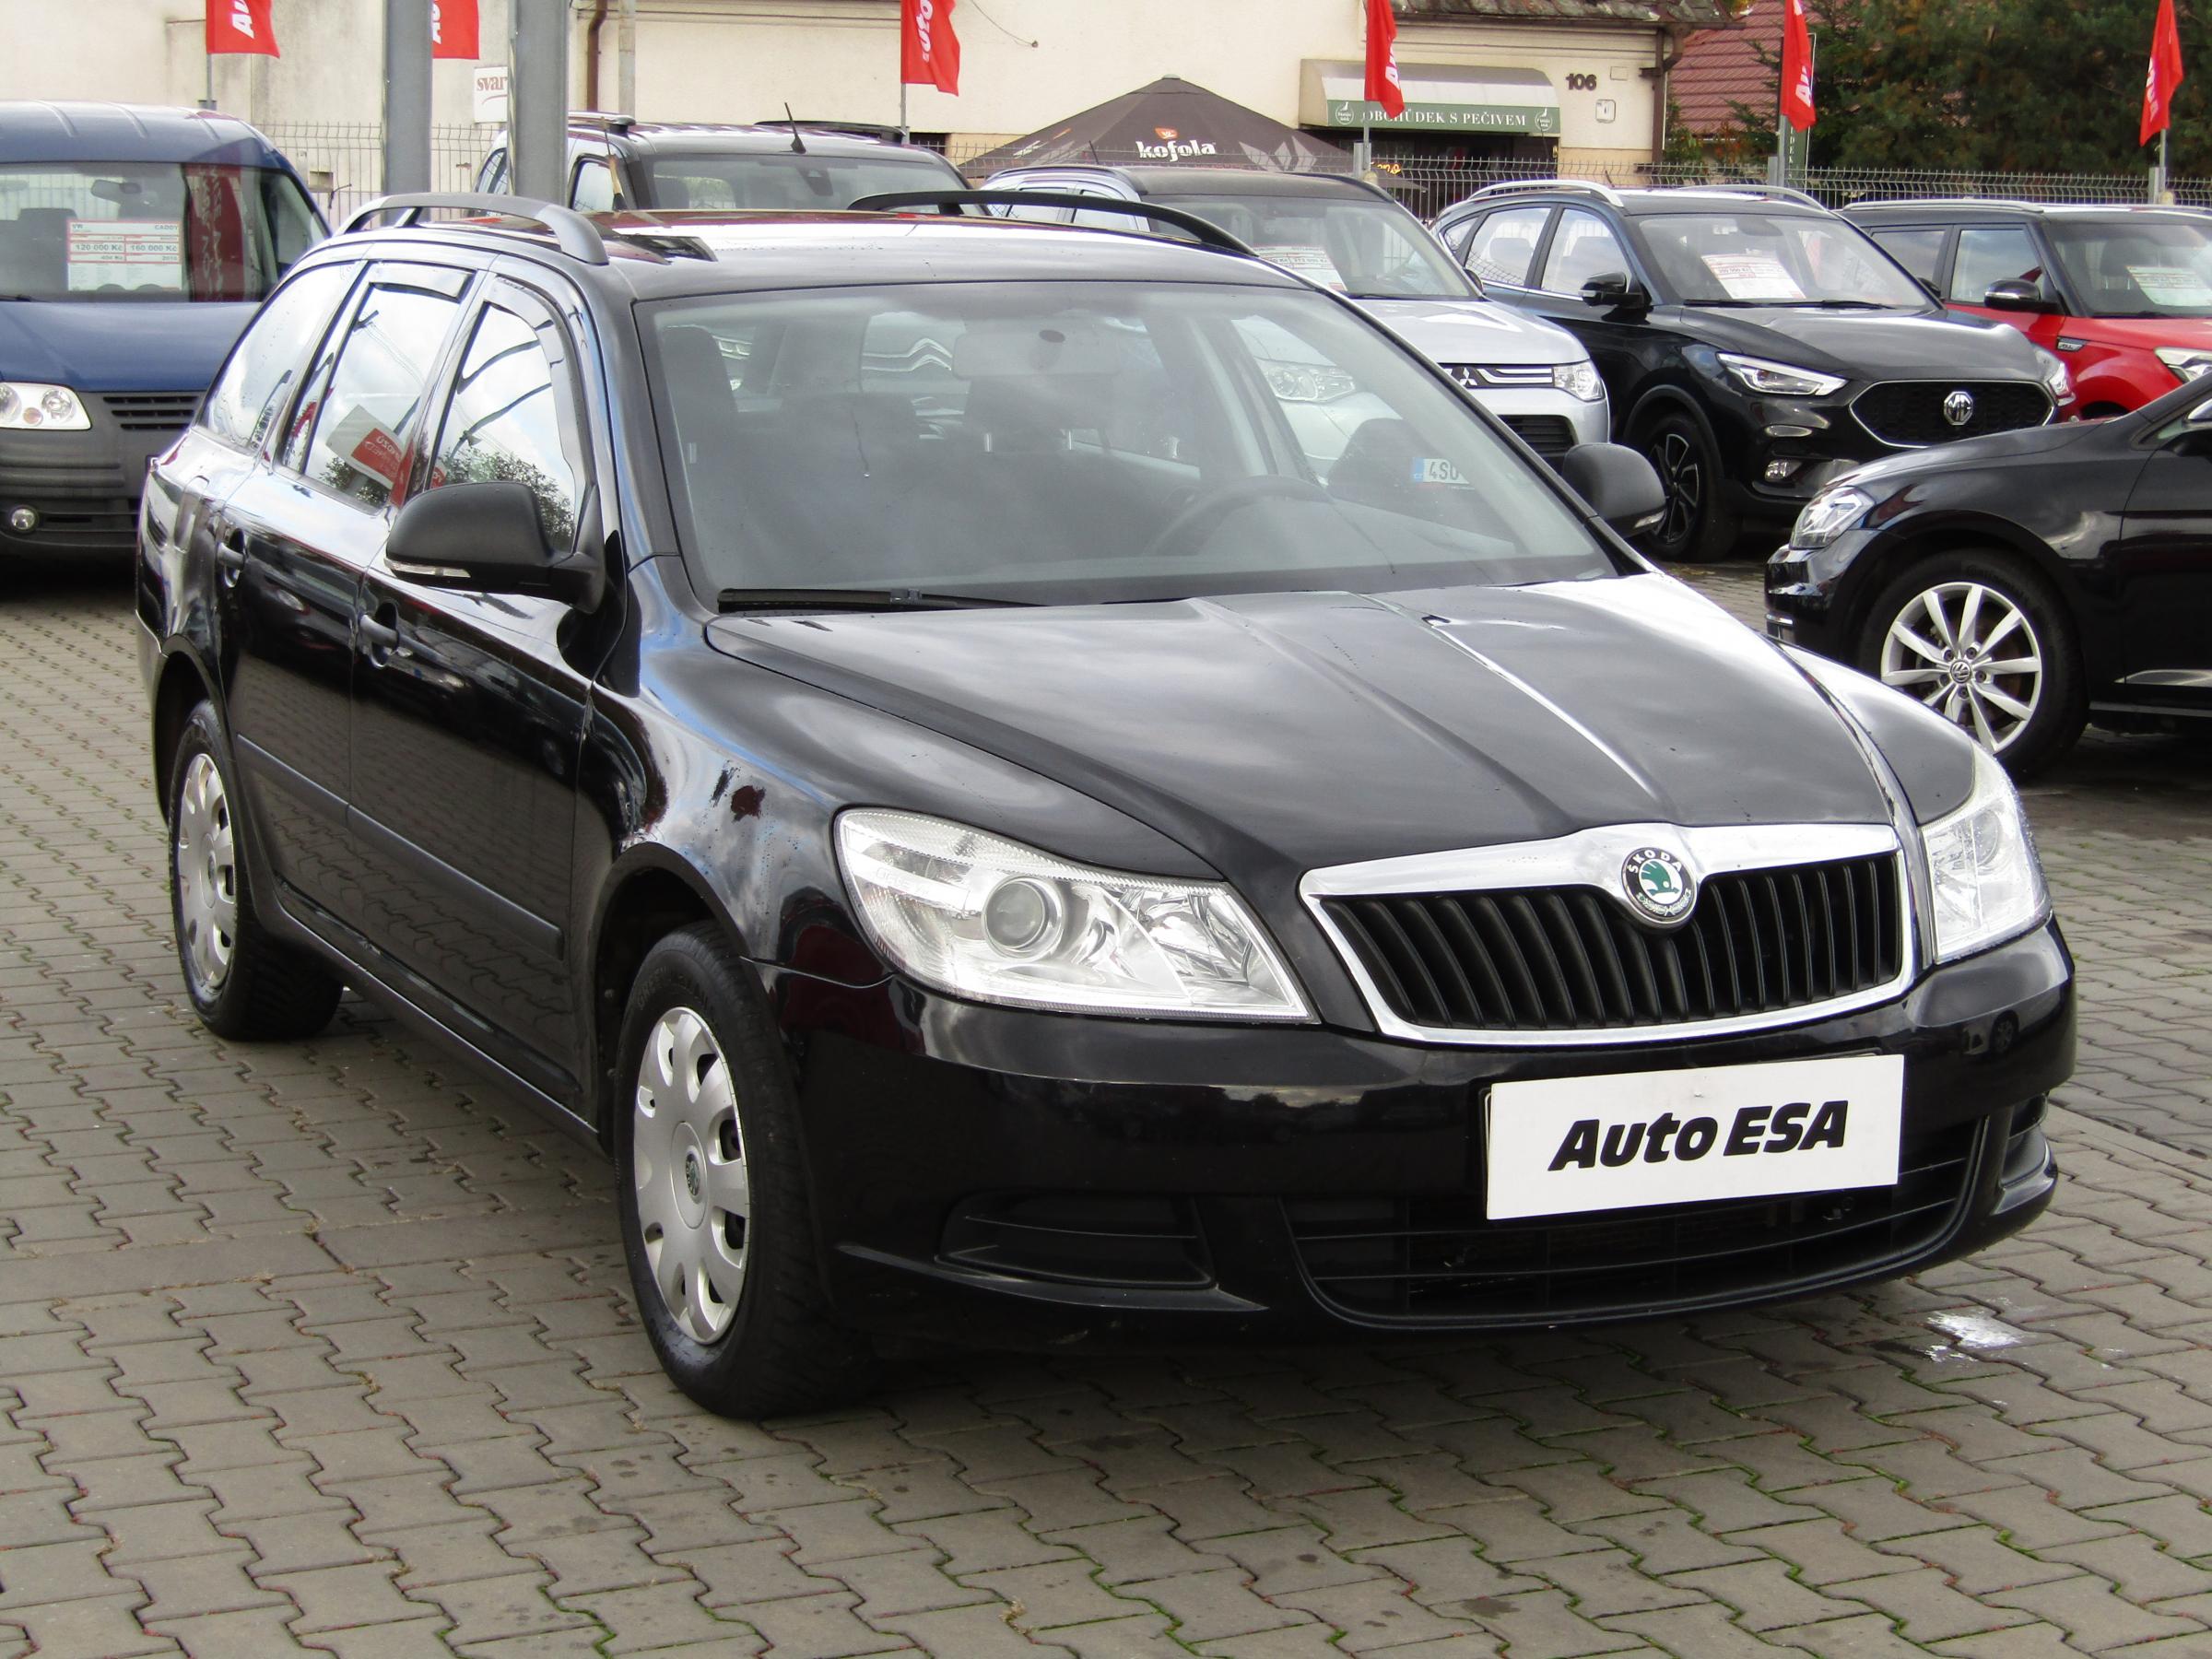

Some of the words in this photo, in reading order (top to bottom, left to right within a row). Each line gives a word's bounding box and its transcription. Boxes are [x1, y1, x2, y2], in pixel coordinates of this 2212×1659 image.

[1566, 73, 1597, 91] 106
[1450, 112, 1458, 124] S
[1463, 112, 1526, 126] PEČIVEM
[1135, 139, 1216, 162] kofola
[1547, 1112, 1718, 1171] Auto
[1723, 1100, 1849, 1157] ESA
